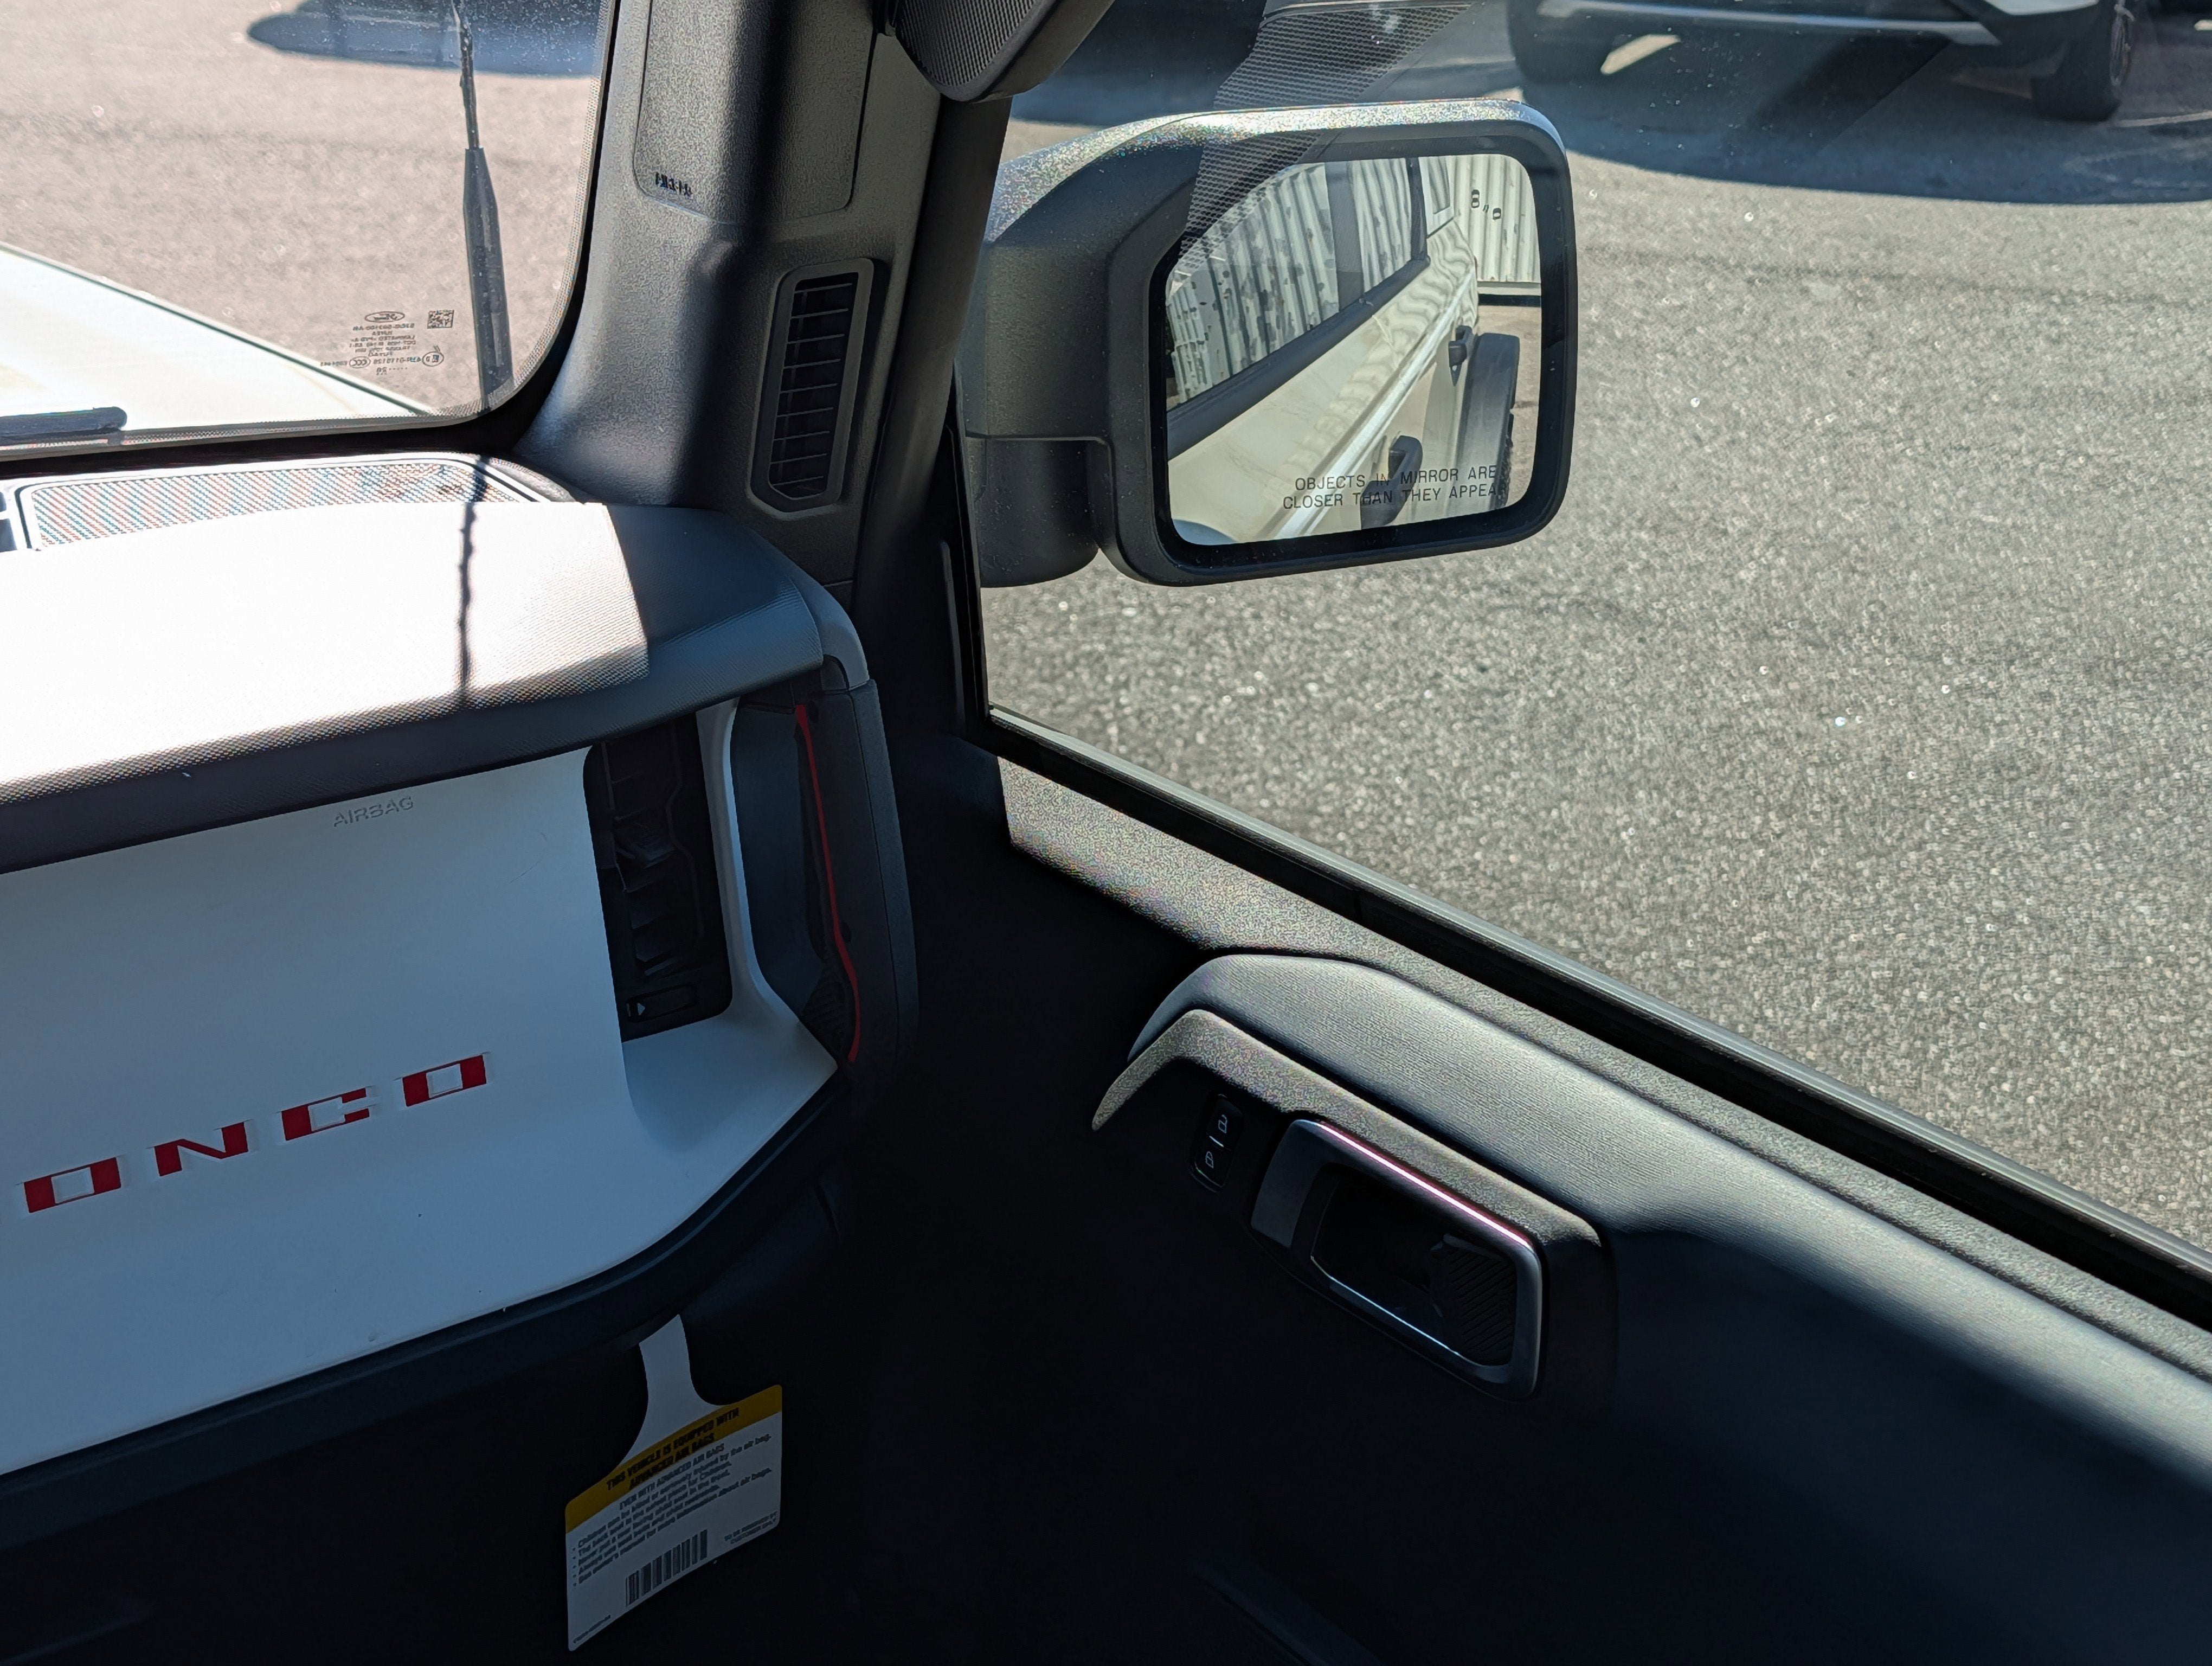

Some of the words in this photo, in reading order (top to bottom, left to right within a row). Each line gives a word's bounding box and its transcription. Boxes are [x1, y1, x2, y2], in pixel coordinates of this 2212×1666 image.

[1295, 475, 1365, 491] OBJECTS
[1375, 473, 1390, 486] IN
[1400, 468, 1458, 485] MIRROR
[1468, 465, 1497, 480] ARE
[1283, 494, 1343, 509] CLOSER
[1352, 490, 1393, 505] THAN
[1402, 486, 1441, 502] THEY
[1449, 482, 1499, 499] APPEA
[333, 796, 414, 828] AIRBAG
